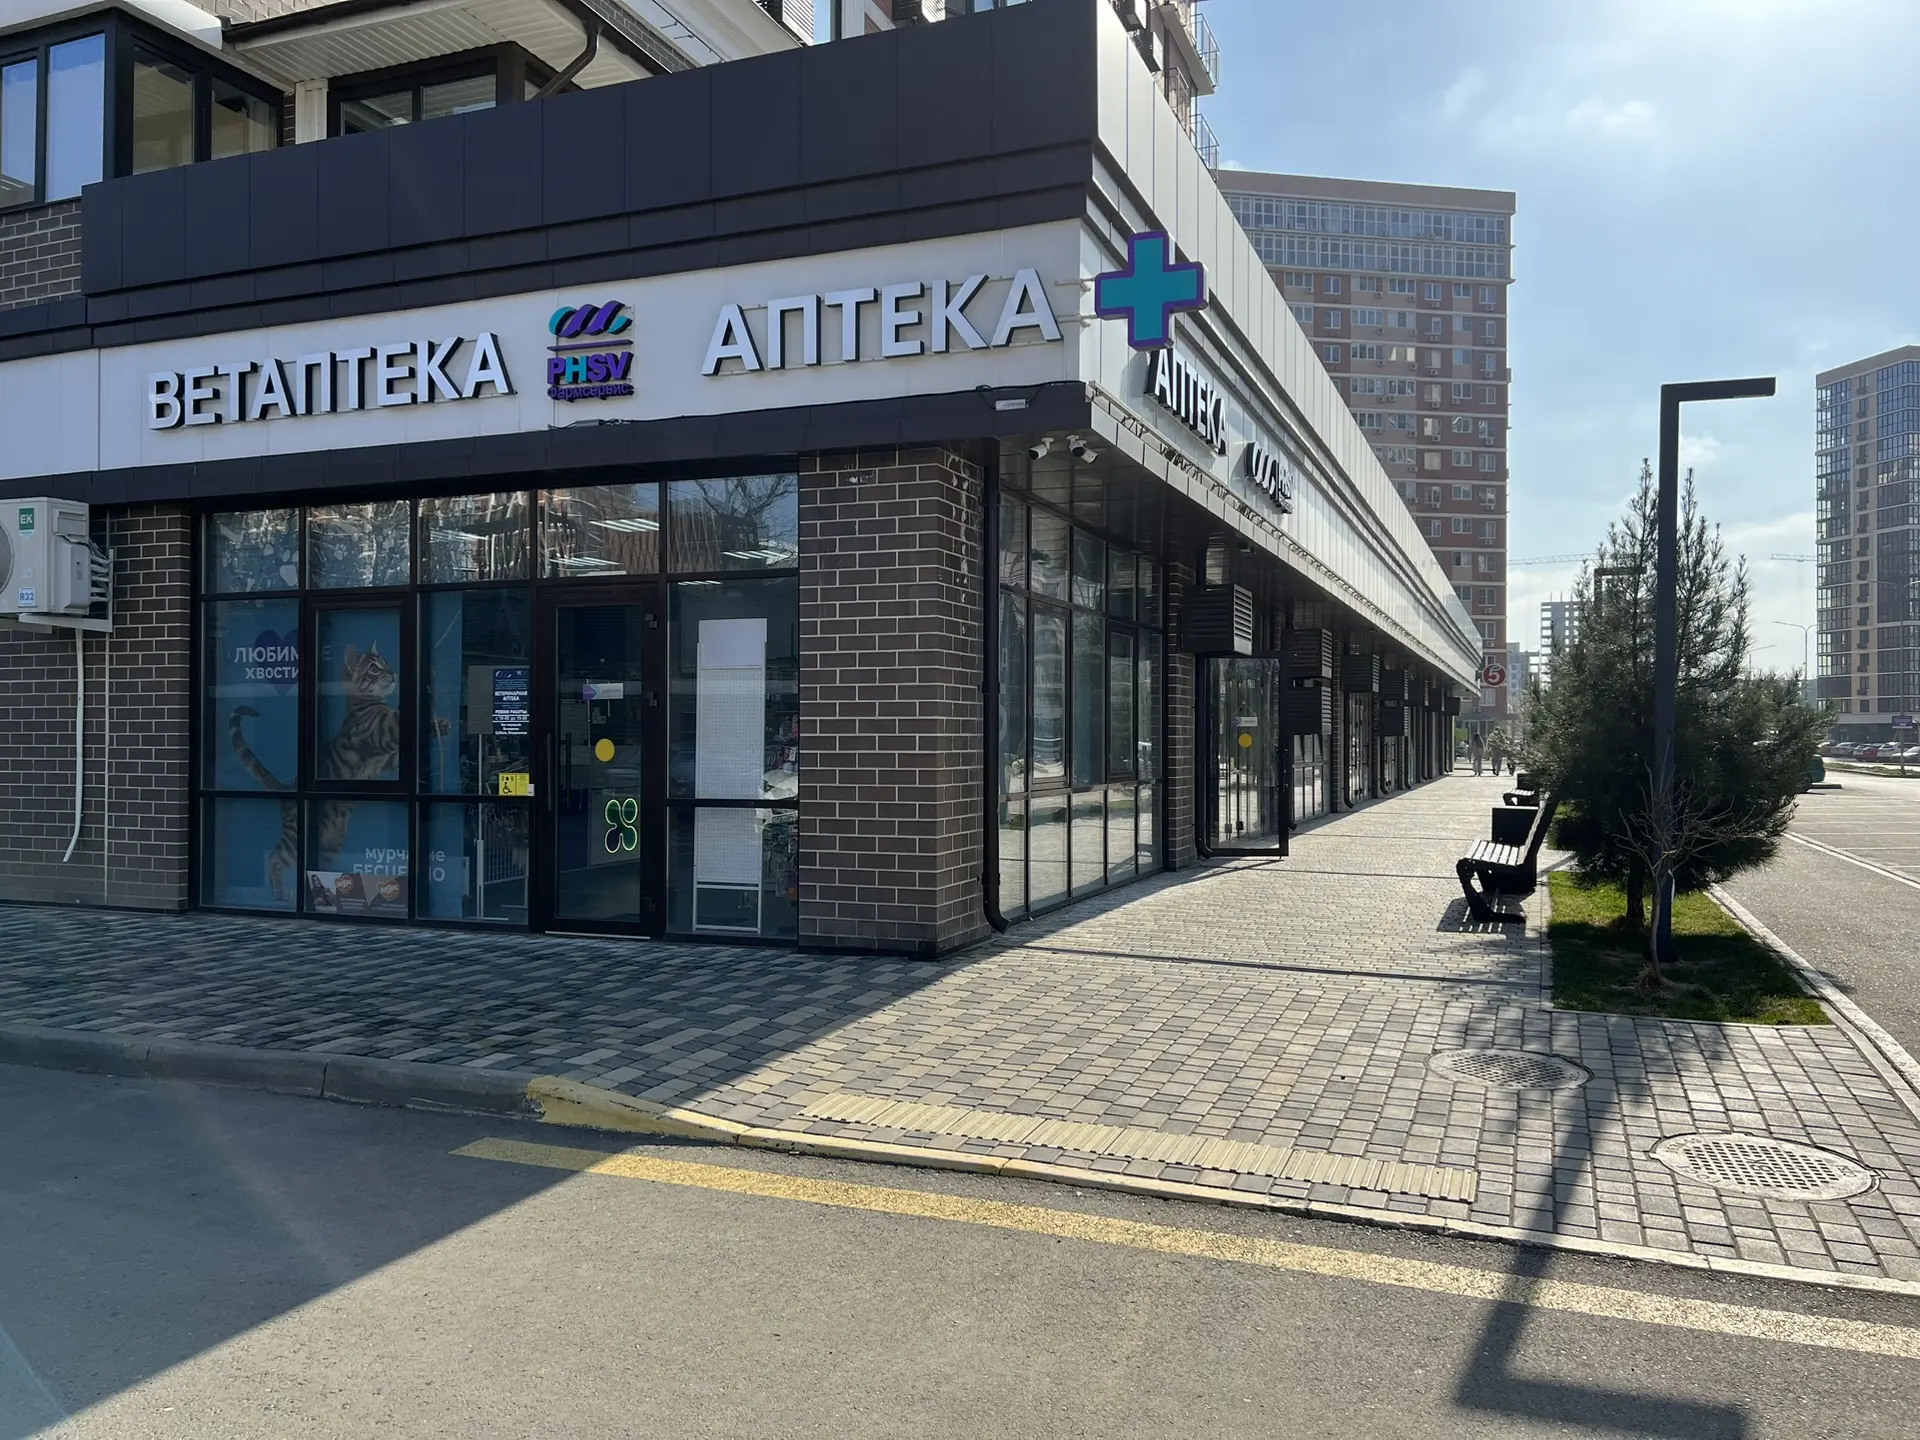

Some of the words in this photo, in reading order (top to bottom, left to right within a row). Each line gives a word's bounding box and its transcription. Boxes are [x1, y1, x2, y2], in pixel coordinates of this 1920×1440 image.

[701, 268, 1062, 376] АПТЕКА
[149, 332, 515, 429] ВЕТАПТЕКА
[547, 352, 633, 385] PHSV
[1147, 347, 1227, 454] АПТЕКА
[20, 514, 33, 524] EK
[20, 592, 35, 601] R32
[1488, 665, 1501, 683] 5
